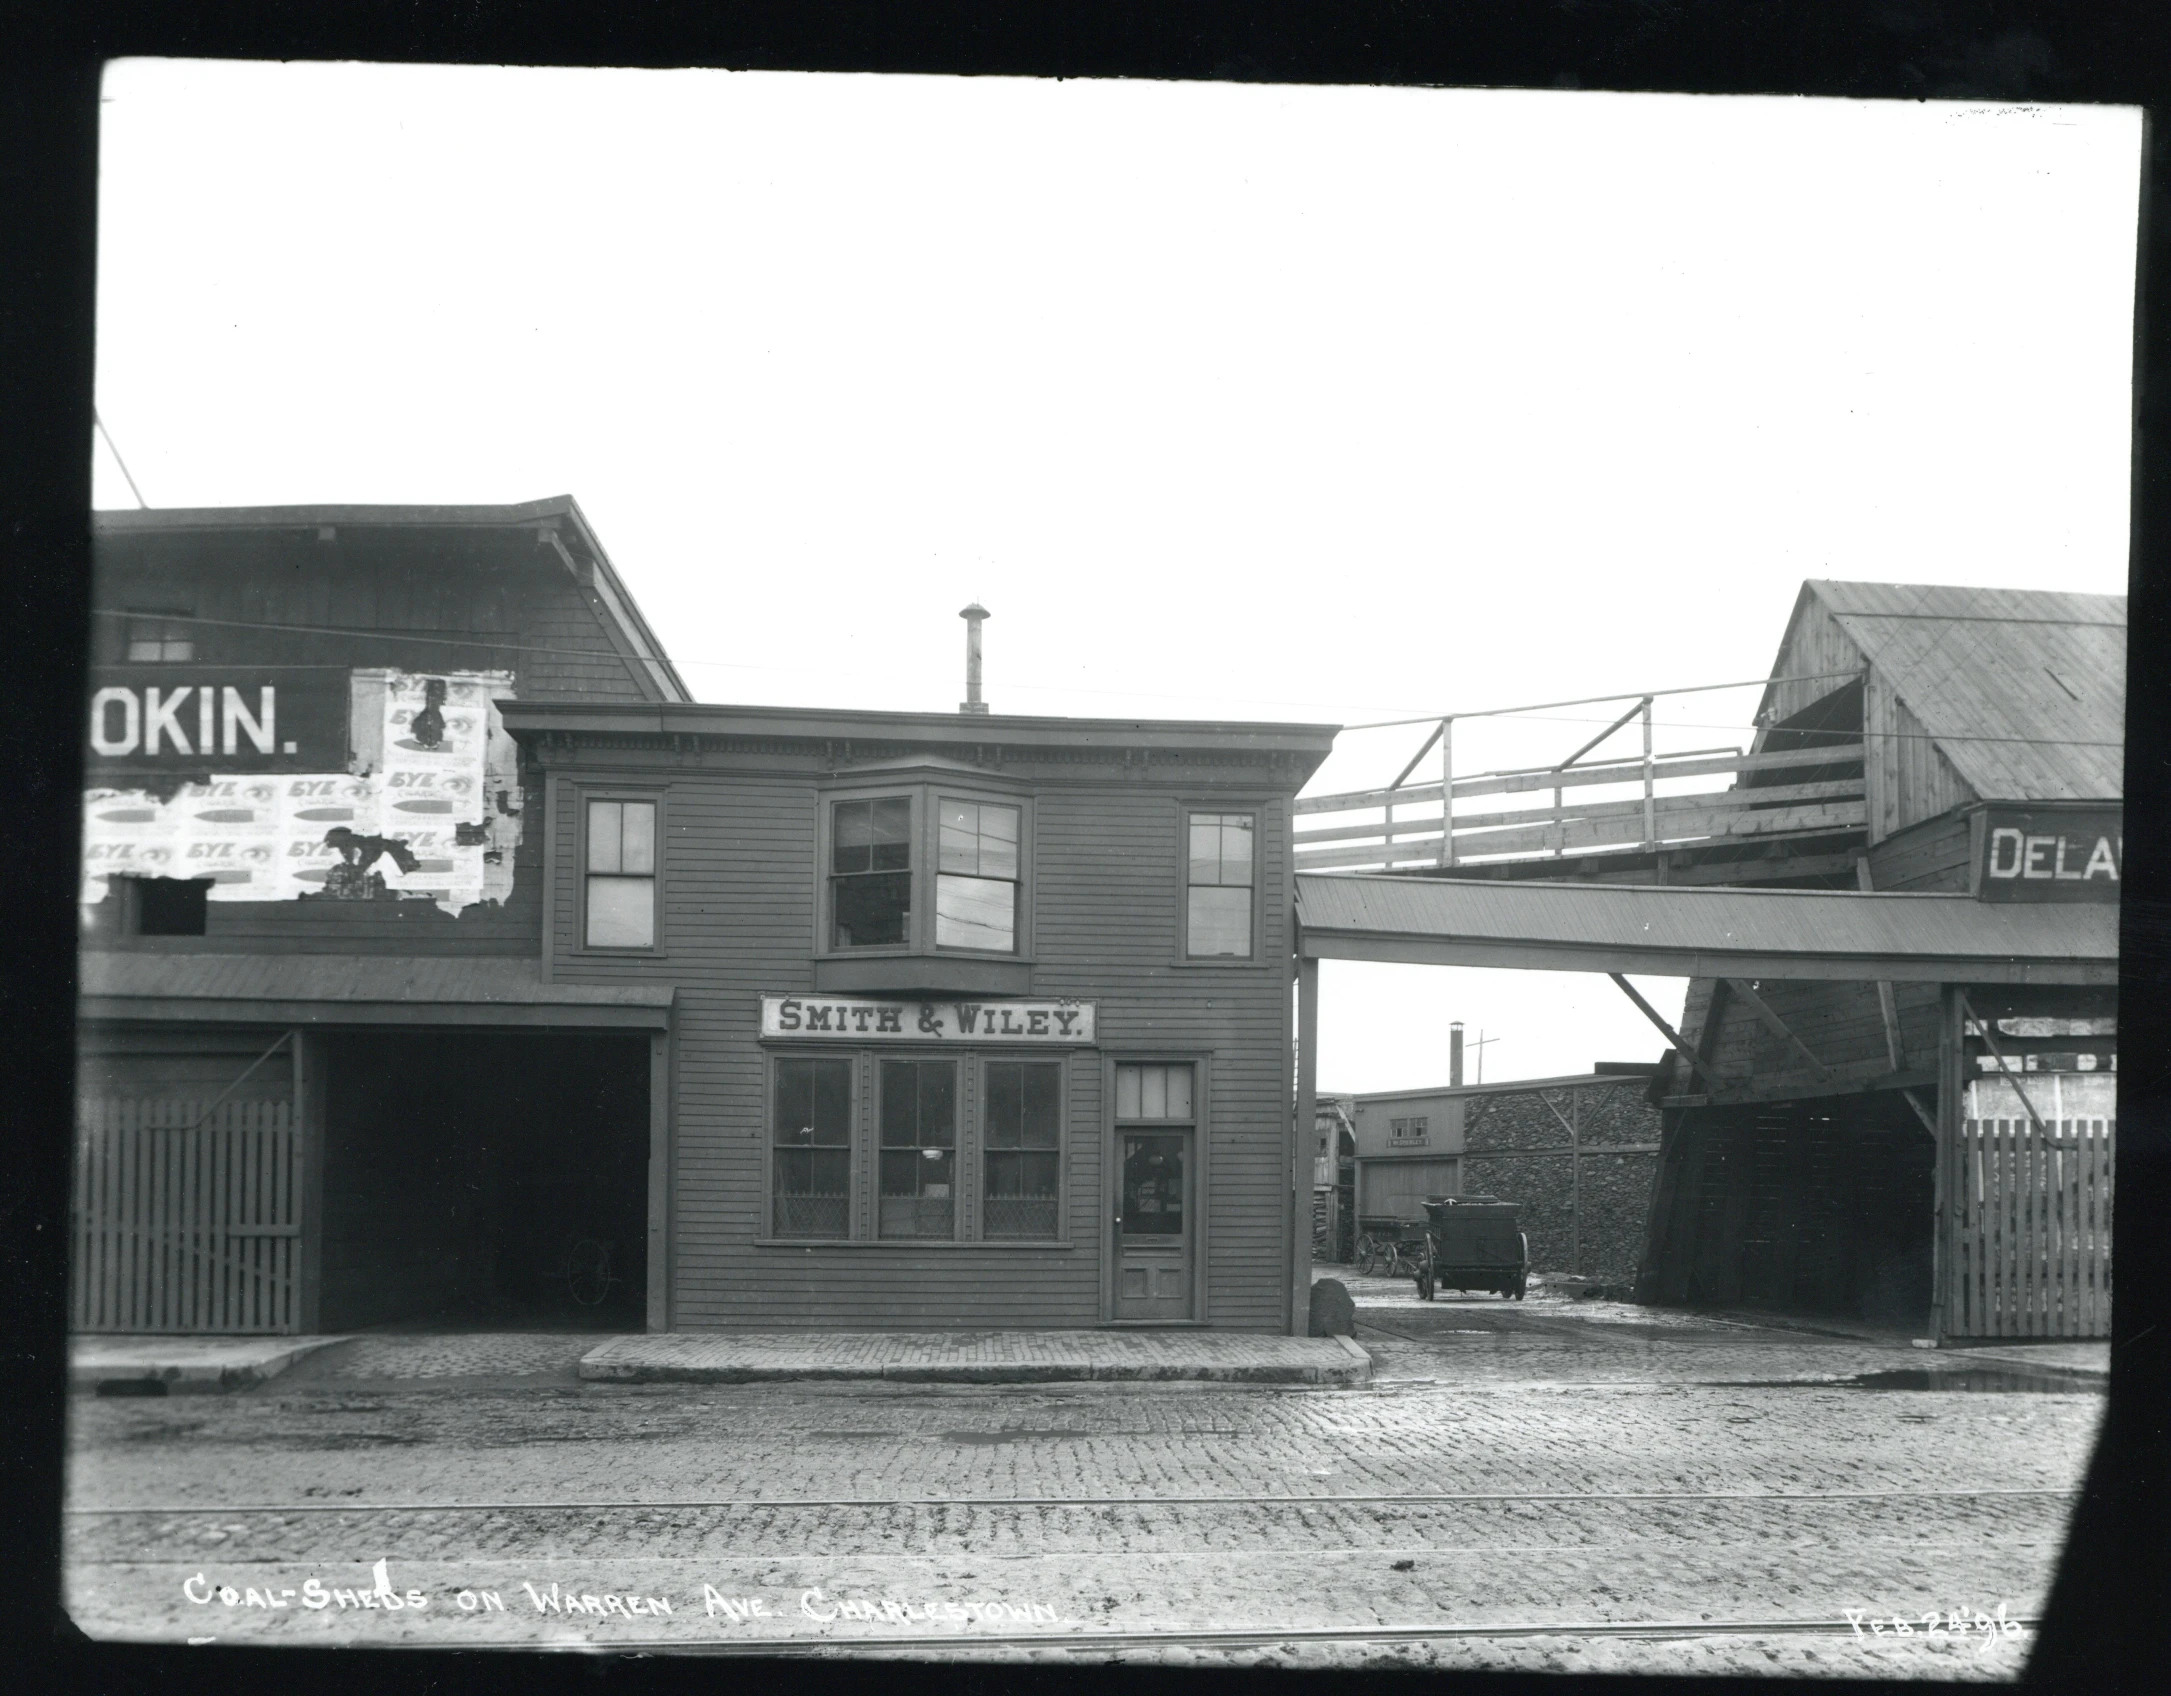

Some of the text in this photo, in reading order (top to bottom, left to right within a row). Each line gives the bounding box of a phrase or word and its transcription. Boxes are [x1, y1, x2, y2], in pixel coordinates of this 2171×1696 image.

[90, 686, 297, 757] OKIN.
[287, 780, 337, 797] EYE
[388, 772, 438, 788] EYE
[186, 842, 236, 858] EYE
[779, 1000, 1083, 1037] SMITH & WILEY.
